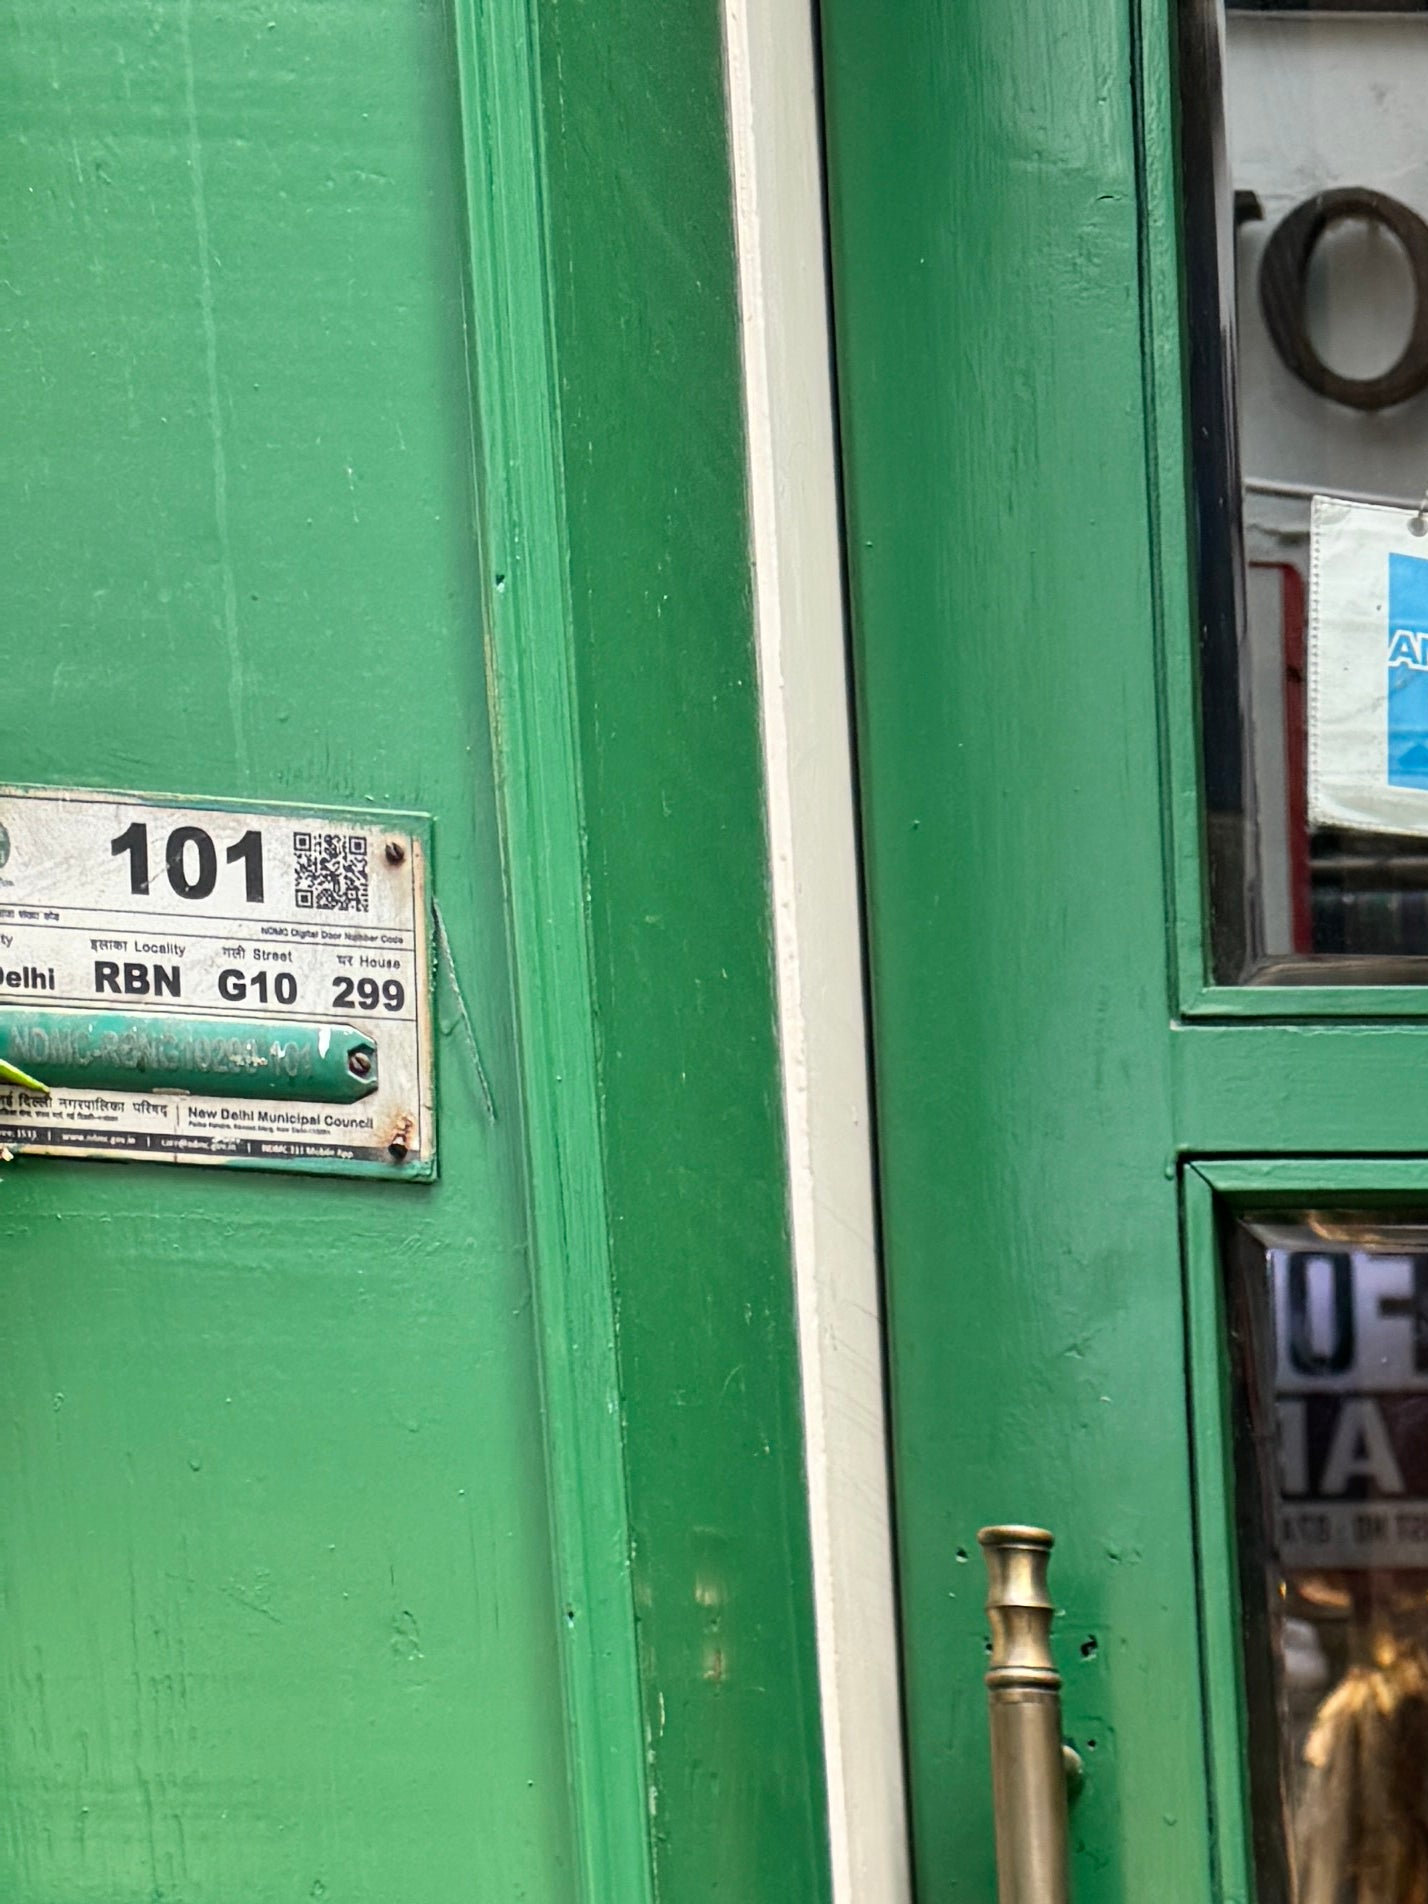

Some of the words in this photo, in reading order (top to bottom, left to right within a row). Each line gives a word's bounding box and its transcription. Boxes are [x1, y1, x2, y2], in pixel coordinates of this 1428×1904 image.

[111, 822, 264, 903] 101
[291, 929, 319, 940] Digital
[321, 931, 342, 940] Door
[344, 933, 378, 942] Number
[380, 936, 403, 945] Code
[90, 939, 128, 953] इलाका
[134, 941, 186, 957] Locality
[222, 945, 245, 960] गली
[253, 949, 293, 963] Street
[359, 956, 401, 970] House
[0, 966, 55, 990] elhi
[95, 960, 181, 998] RBN
[218, 969, 298, 1006] G10
[332, 976, 405, 1012] 299
[59, 1097, 125, 1113] नगरपालिका
[188, 1107, 217, 1120] New
[220, 1108, 254, 1122] Delhi
[258, 1111, 320, 1126] Municipal
[324, 1115, 373, 1129] Council
